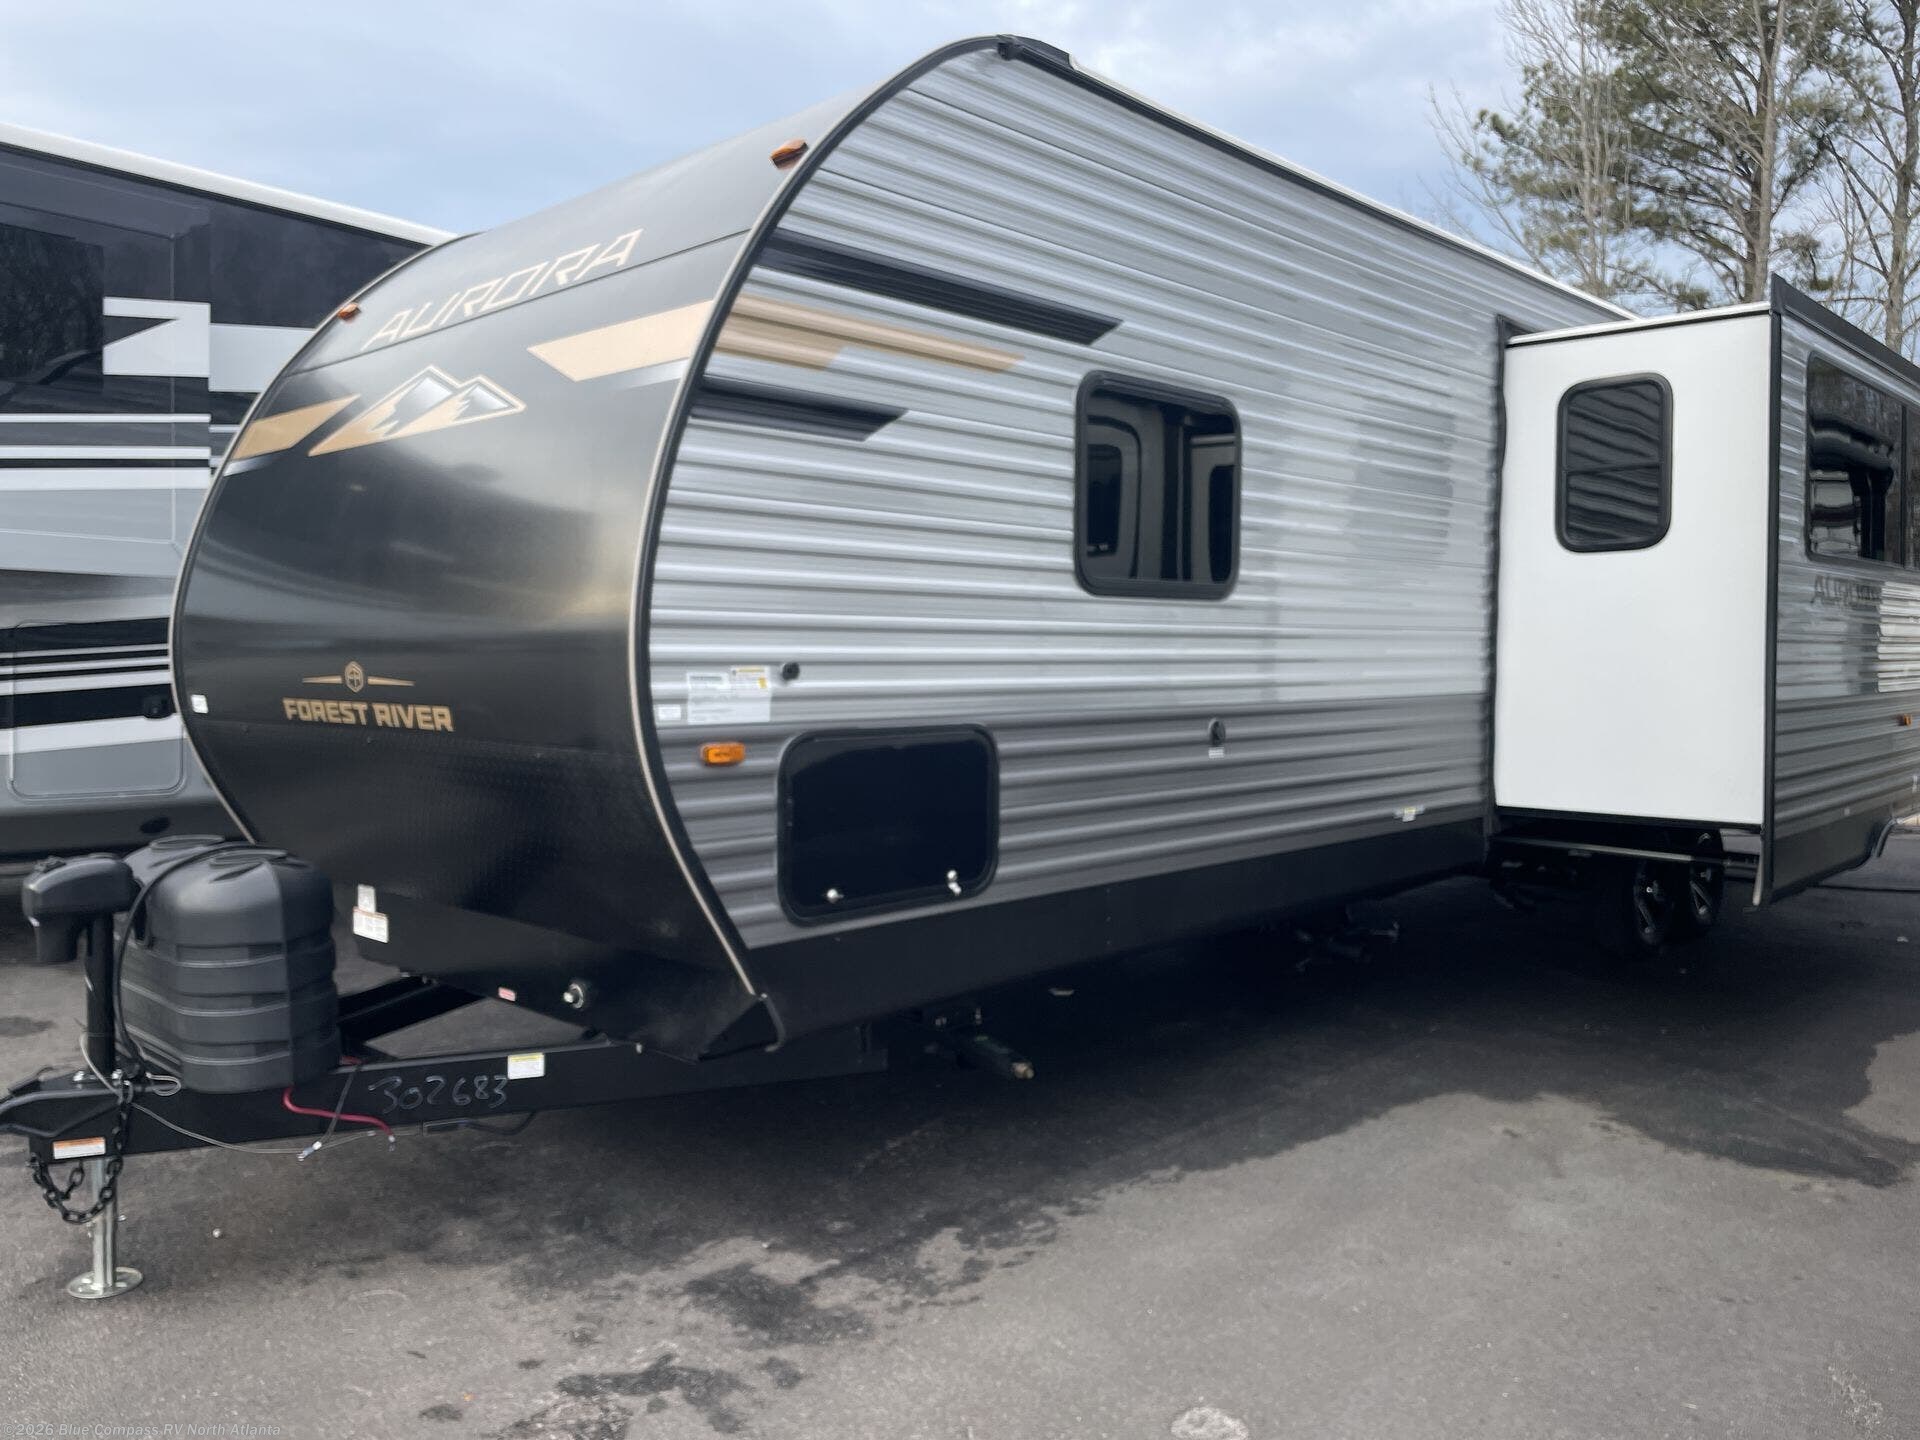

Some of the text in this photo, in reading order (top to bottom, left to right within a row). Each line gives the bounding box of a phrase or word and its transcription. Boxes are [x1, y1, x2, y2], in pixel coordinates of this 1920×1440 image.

[360, 228, 645, 351] AURORA
[283, 698, 455, 732] FOREST RIVER
[367, 1075, 509, 1114] 302683
